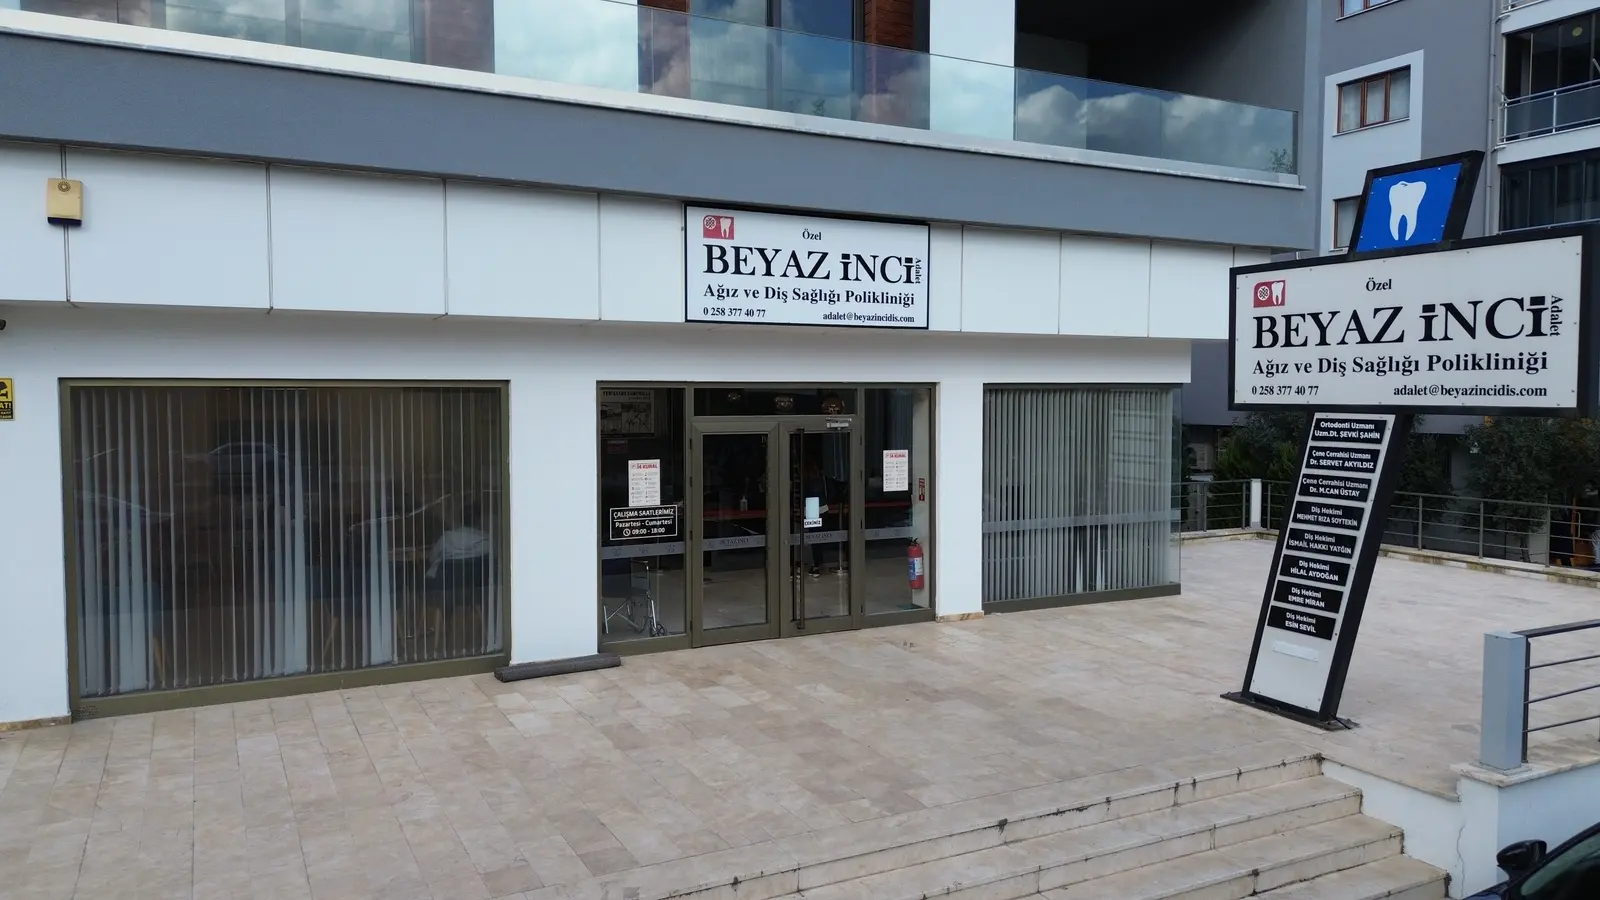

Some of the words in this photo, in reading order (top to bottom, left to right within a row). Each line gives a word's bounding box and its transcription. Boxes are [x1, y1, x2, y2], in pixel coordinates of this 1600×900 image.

[802, 228, 821, 240] Özel
[703, 244, 830, 280] BEYAZ
[1366, 277, 1392, 291] Özel
[704, 284, 738, 301] Ağız
[744, 289, 759, 299] ve
[765, 286, 788, 303] Diş
[792, 288, 840, 305] Sağlığı
[845, 290, 914, 308] Polikliniği
[703, 307, 709, 315] 0
[711, 307, 726, 316] 258
[728, 308, 742, 317] 377
[744, 309, 754, 317] 40
[756, 309, 766, 317] 77
[823, 312, 914, 323] adalet@beyazincidis.com
[1550, 295, 1563, 336] Adalet
[1252, 306, 1405, 348] BEYAZ
[1253, 359, 1288, 376] Ağız
[1294, 363, 1312, 373] ve
[1318, 357, 1346, 377] Diş
[1352, 355, 1419, 376] Sağlığı
[1427, 351, 1548, 375] Polikliniği
[1252, 386, 1257, 395] 0
[1259, 386, 1274, 395] 258
[1276, 385, 1292, 395] 377
[1294, 386, 1306, 395] 40
[1308, 386, 1319, 395] 77
[1394, 384, 1547, 399] adalet@beyazincidis.com
[1360, 431, 1380, 439] ŞAHİN
[1312, 450, 1325, 459] Çene
[1344, 461, 1374, 469] AKYILDIZ
[1302, 477, 1318, 486] Çene
[1318, 478, 1345, 487] Cerrahisi
[1346, 480, 1369, 489] Uzmanı
[1319, 487, 1339, 495] M.CAN
[1340, 488, 1360, 497] ÜSTAY
[613, 511, 638, 519] ÇALIŞMA
[639, 508, 674, 516] SAATLERİMİZ
[1311, 506, 1320, 514] Diş
[1321, 507, 1342, 515] Hekimi
[1297, 513, 1317, 521] MEHMET
[1318, 515, 1330, 523] RIZA
[1304, 533, 1313, 541] Diş
[1315, 534, 1335, 542] Hekimi
[1289, 538, 1308, 549] İSMAİL
[1309, 542, 1328, 550] HAKKI
[1299, 560, 1308, 568] Diş
[1309, 562, 1329, 571] Hekimi
[1290, 567, 1307, 576] HİLAL
[1308, 570, 1338, 581] AYDOĞAN
[1291, 587, 1300, 595] Diş
[1301, 589, 1321, 598] Hekimi
[1288, 595, 1304, 603] EMRE
[1305, 598, 1325, 607] MİRAN
[1286, 612, 1295, 620] Diş
[1296, 615, 1316, 624] Hekimi
[1285, 620, 1298, 629] ESİN
[1299, 624, 1316, 633] SEVİL
